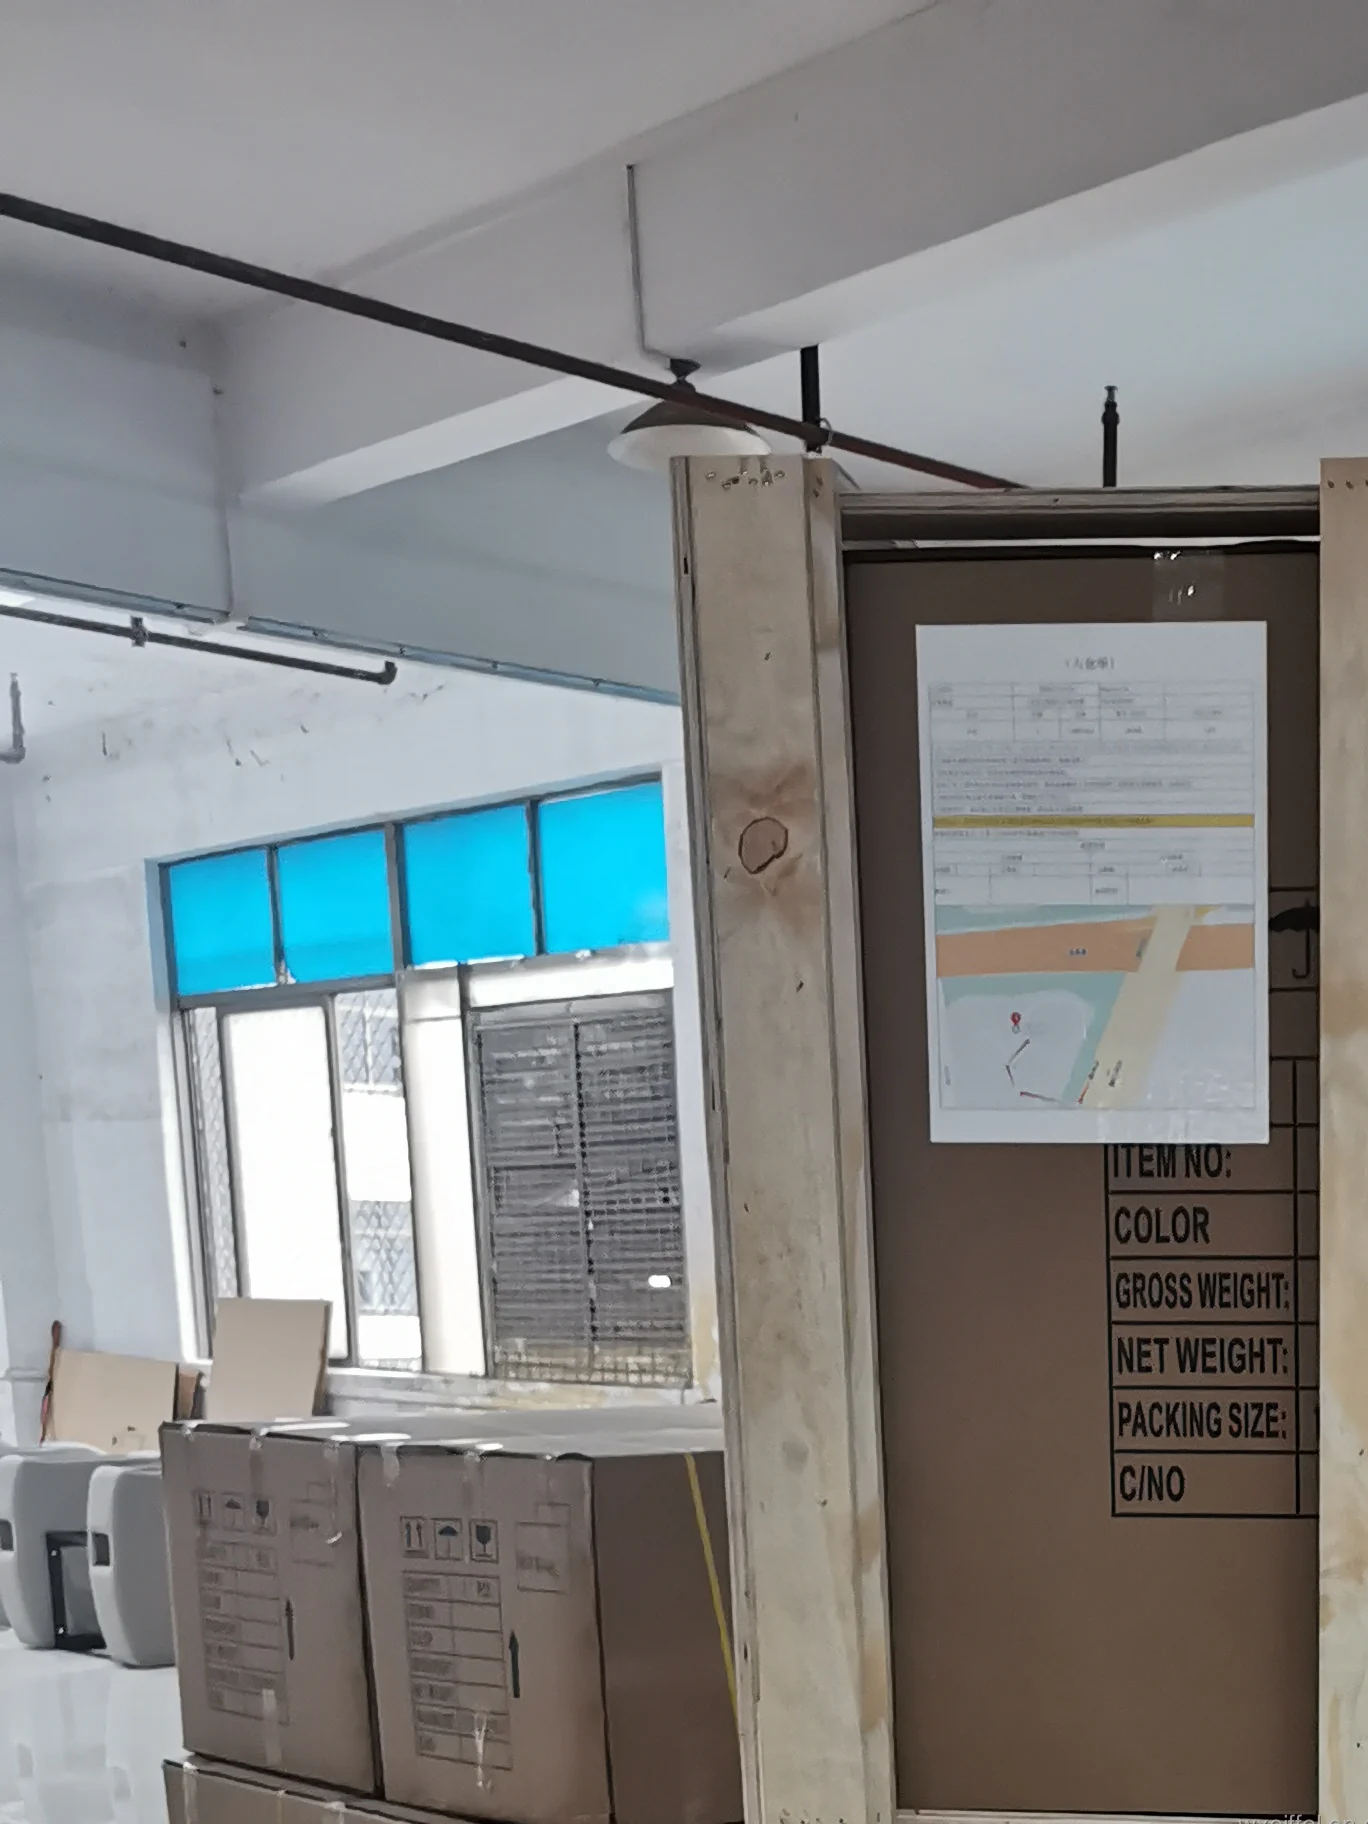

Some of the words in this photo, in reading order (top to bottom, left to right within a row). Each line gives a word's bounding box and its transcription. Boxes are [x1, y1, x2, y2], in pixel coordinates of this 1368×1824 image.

[1113, 1143, 1176, 1178] ITEM
[1184, 1143, 1231, 1178] NO:
[1114, 1206, 1210, 1244] COLOR
[1115, 1272, 1193, 1309] GROSS
[1198, 1272, 1290, 1309] WEIGHT:
[1116, 1336, 1169, 1374] NET
[1176, 1337, 1288, 1374] WEIGHT:
[1117, 1401, 1222, 1439] PACKING
[1228, 1402, 1287, 1439] SIZE:
[1119, 1464, 1186, 1502] C/NO
